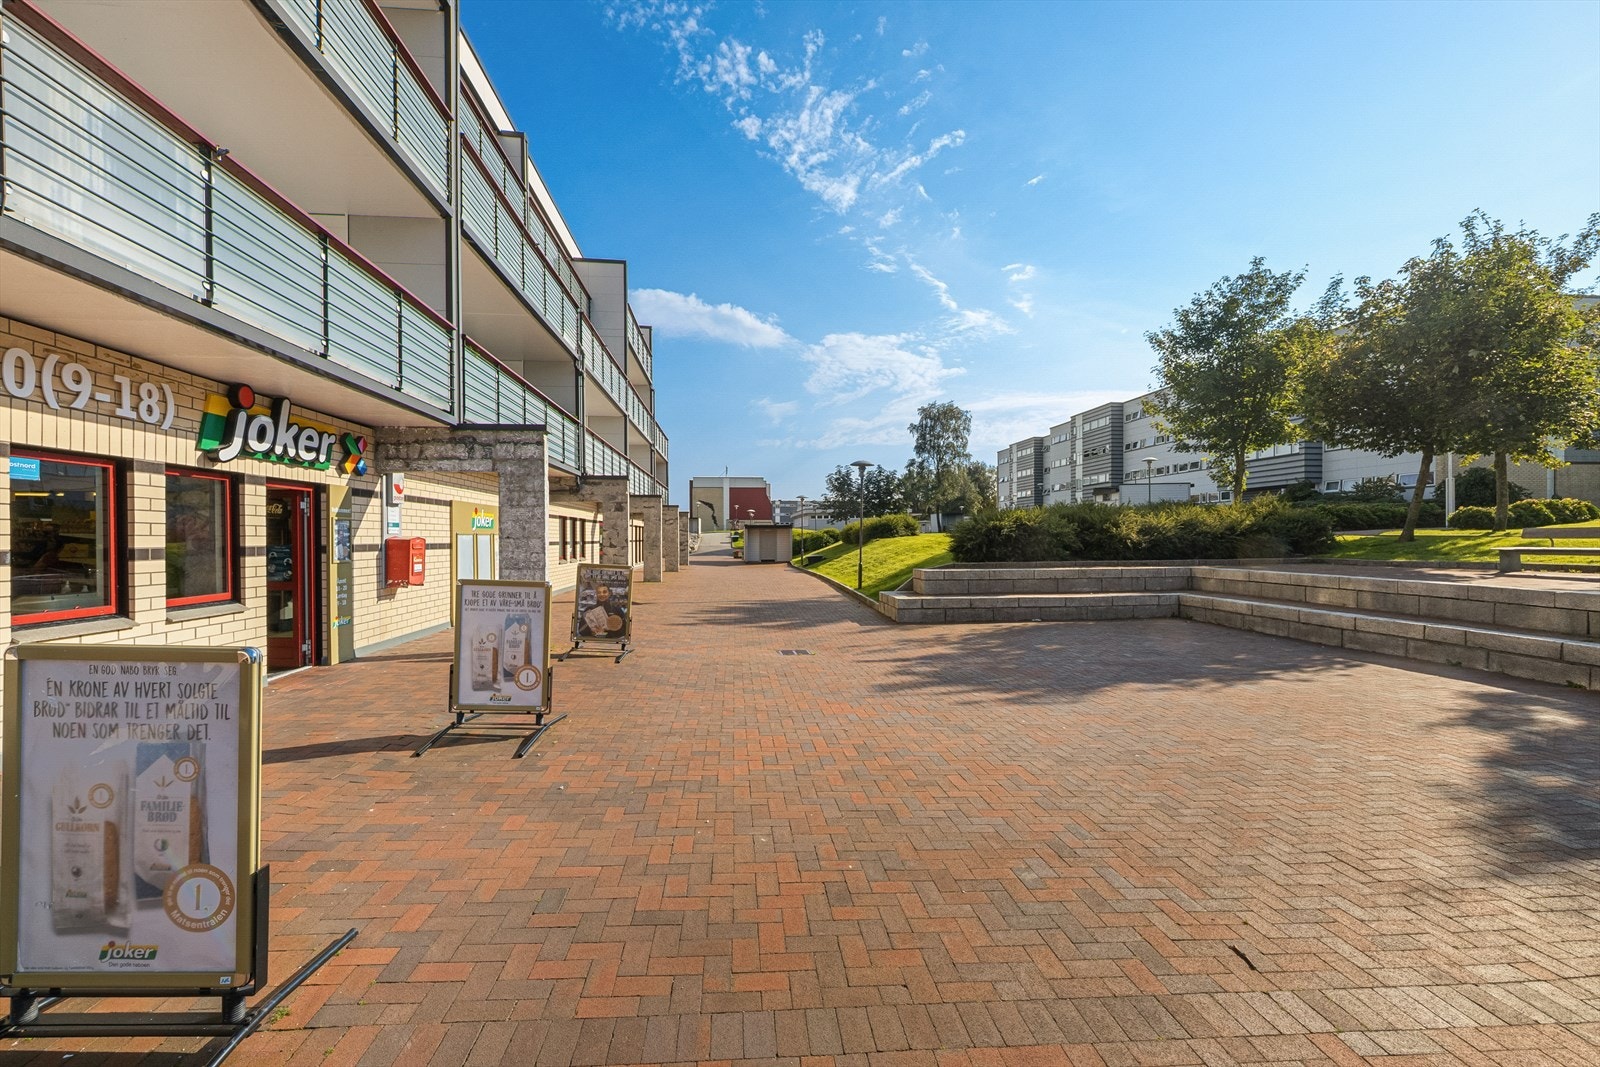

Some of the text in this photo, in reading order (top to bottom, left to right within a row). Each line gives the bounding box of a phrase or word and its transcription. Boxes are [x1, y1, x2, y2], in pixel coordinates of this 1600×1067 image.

[217, 384, 337, 463] joker
[472, 507, 494, 531] joker
[482, 590, 496, 598] GODE
[498, 591, 522, 599] GRUNNER
[88, 664, 99, 675] EN
[100, 664, 116, 675] GOD
[120, 665, 139, 676] NABO
[143, 665, 160, 676] BRYR
[46, 678, 218, 700] ÉN KRONE AV HVERT SOLGTE
[75, 702, 118, 719] BIDRAR
[125, 702, 140, 719] TIL
[146, 702, 159, 719] ET
[165, 700, 209, 720] MÅLTID
[215, 703, 231, 720] TIL
[52, 722, 212, 741] NOEN SOM TRENGER DET.
[170, 909, 228, 929] Matsentralen
[101, 940, 155, 962] joker
